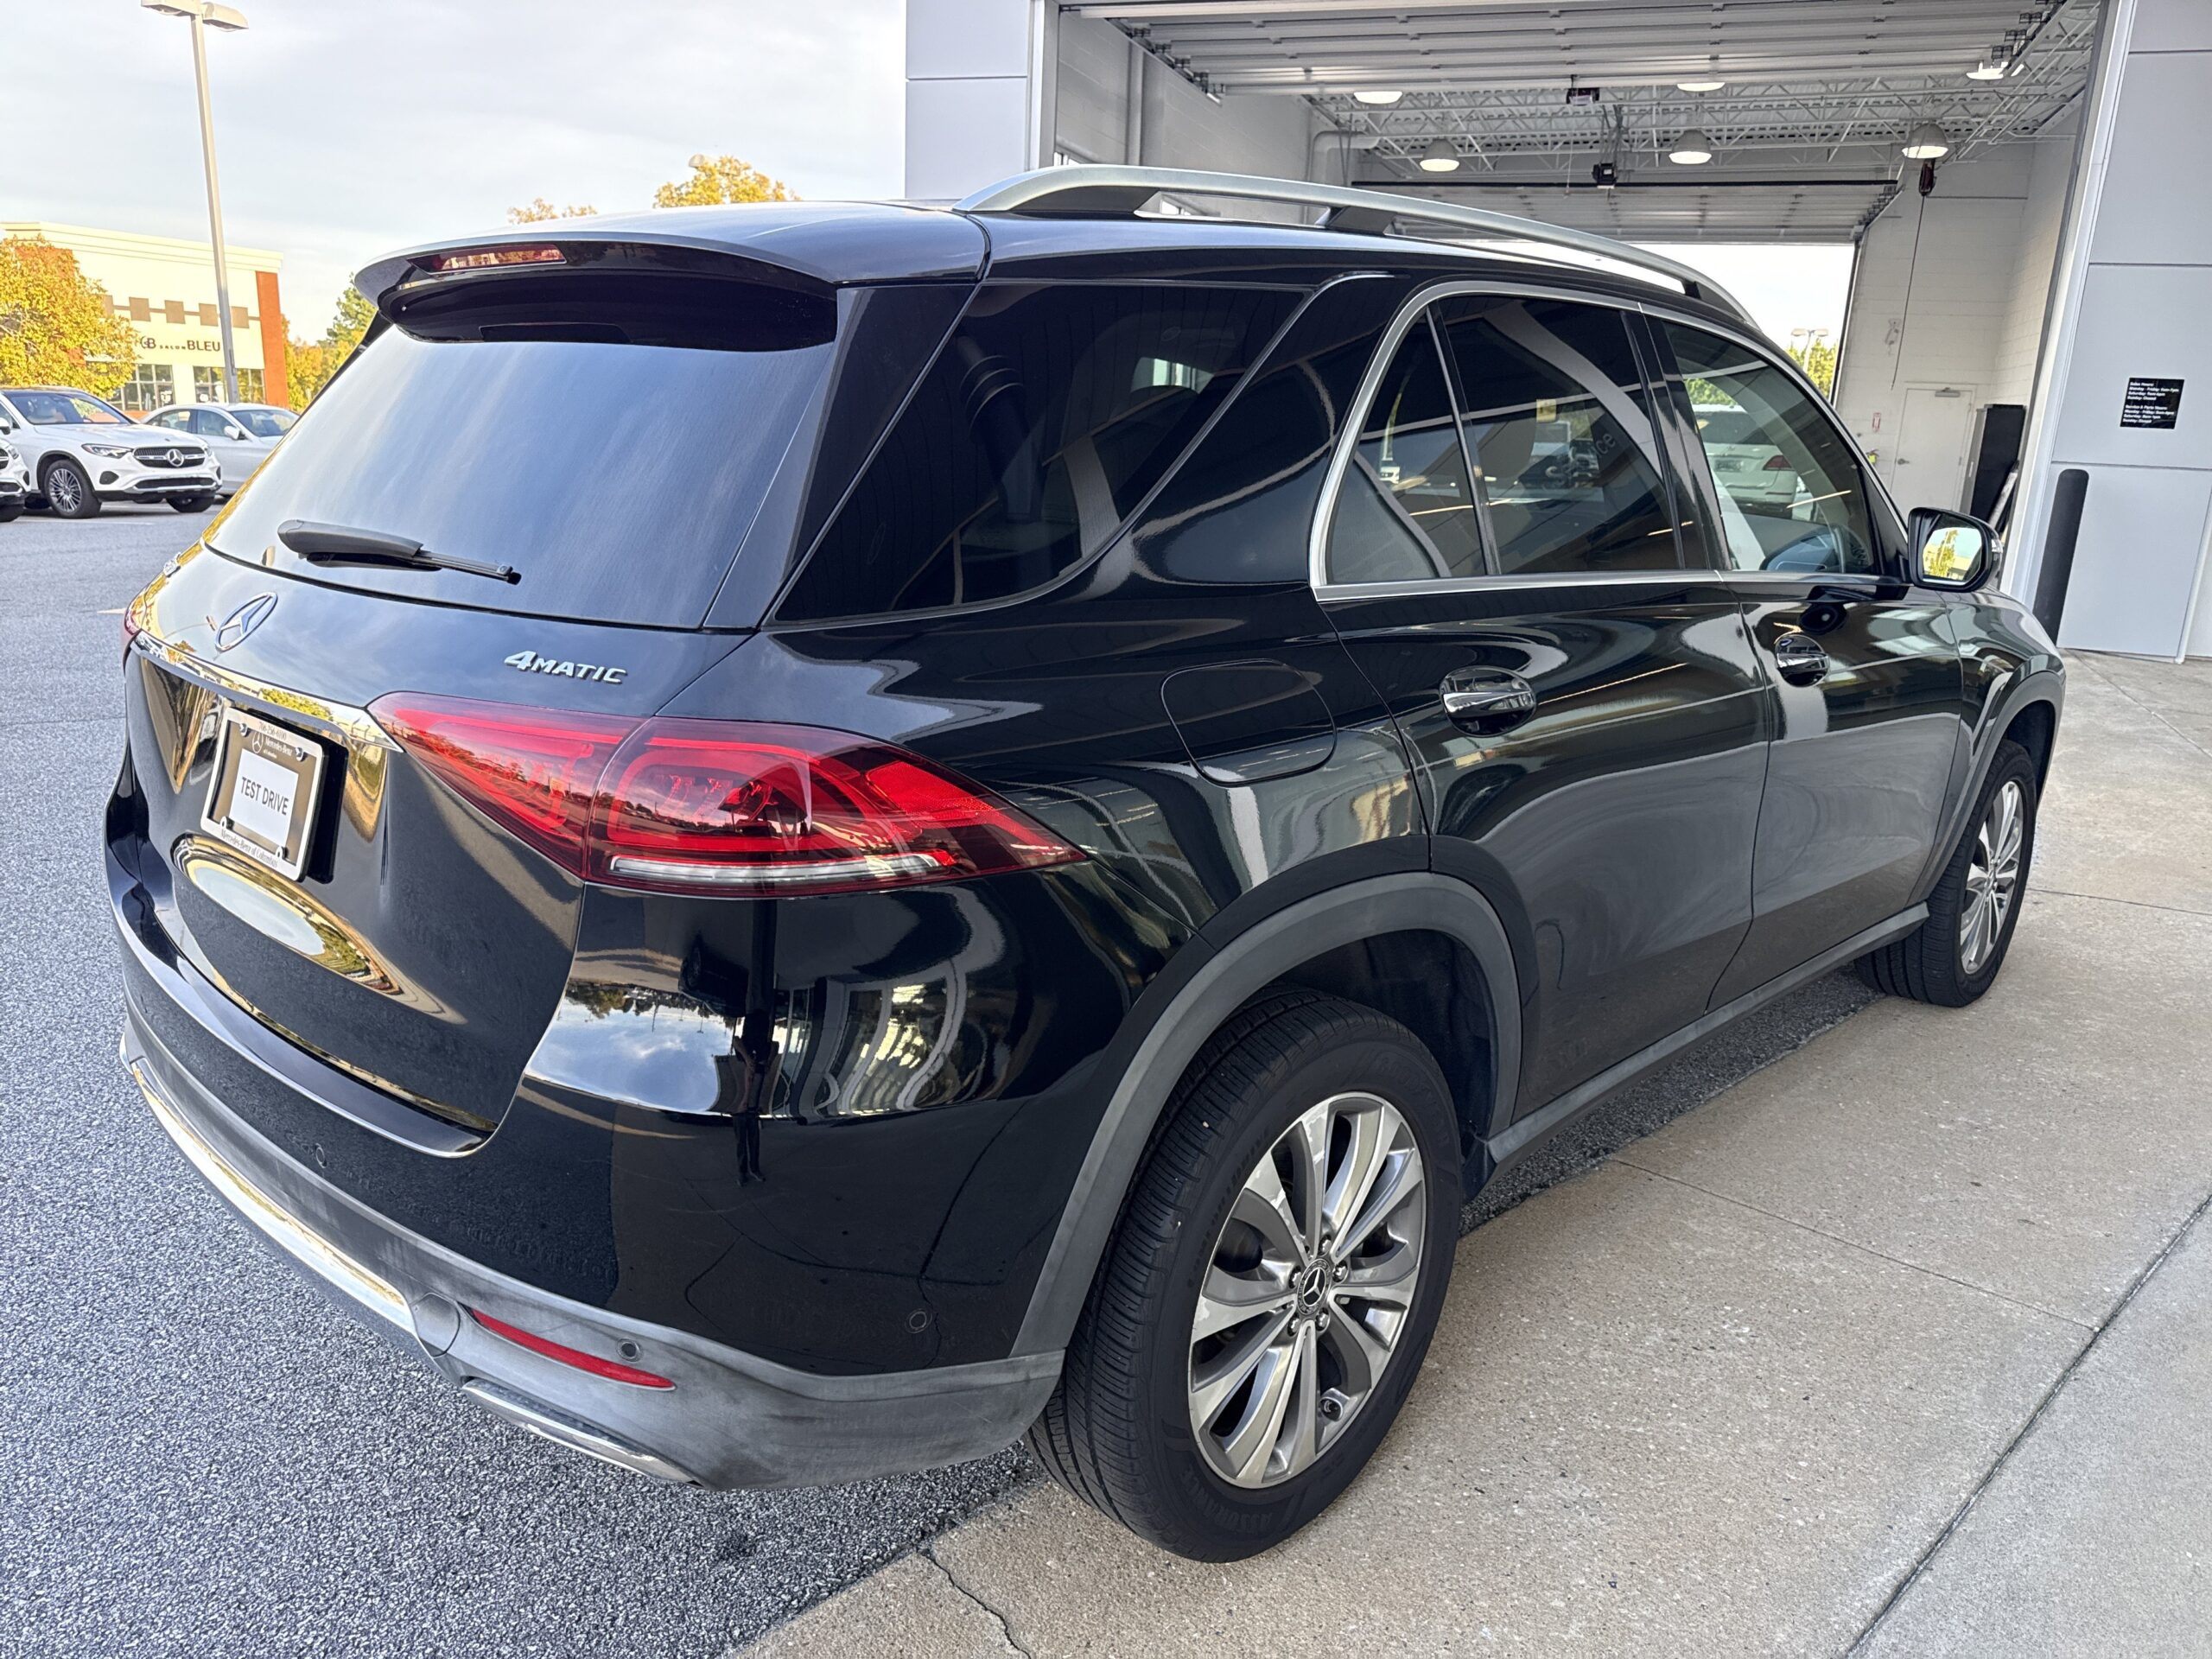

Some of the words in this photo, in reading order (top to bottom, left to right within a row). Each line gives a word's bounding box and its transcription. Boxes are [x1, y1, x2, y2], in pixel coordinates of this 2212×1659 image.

[187, 340, 220, 352] BLEU
[504, 650, 628, 683] 4MATIC
[265, 735, 293, 757] Mercedes-Benz
[241, 776, 262, 802] TEST
[262, 787, 289, 816] DRIVE
[221, 829, 251, 853] Mercedes-Benz
